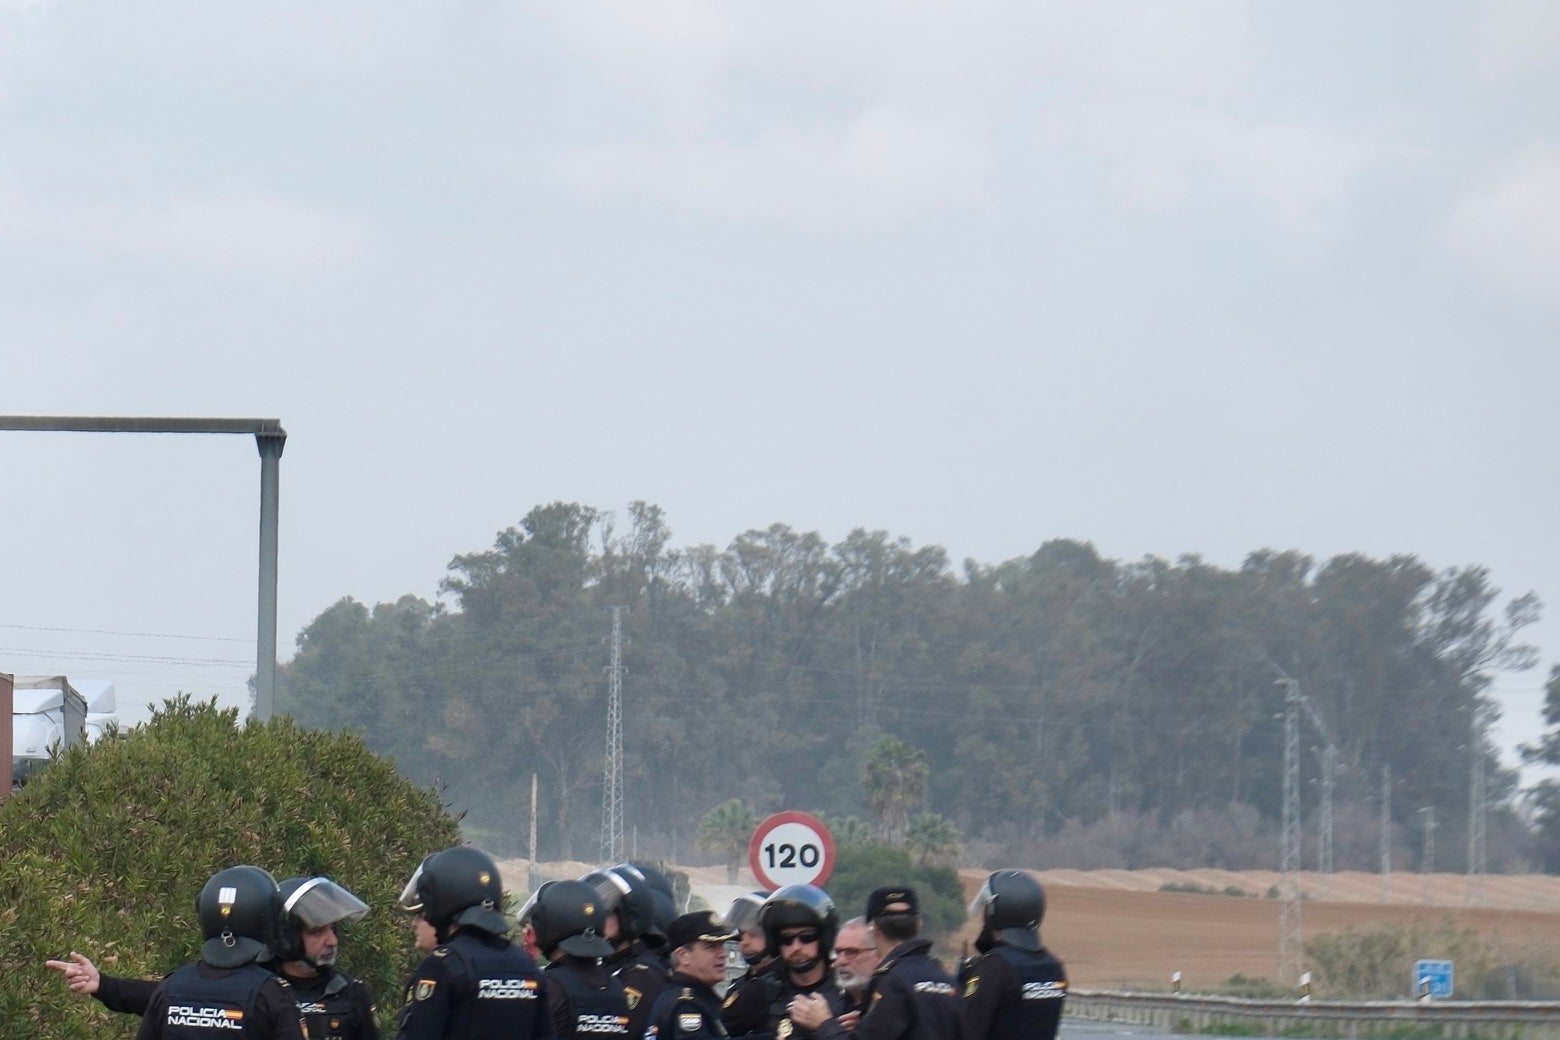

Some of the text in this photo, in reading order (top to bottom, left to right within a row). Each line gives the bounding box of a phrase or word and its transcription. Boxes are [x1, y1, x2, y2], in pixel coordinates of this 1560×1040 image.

[764, 843, 820, 868] 120
[479, 979, 528, 990] POLICIA
[478, 989, 538, 1000] NACIONAL
[168, 1005, 228, 1019] POLICIA
[168, 1015, 243, 1030] NACIONAL
[577, 1014, 620, 1025] POLICIA
[576, 1023, 629, 1034] NACIONAL
